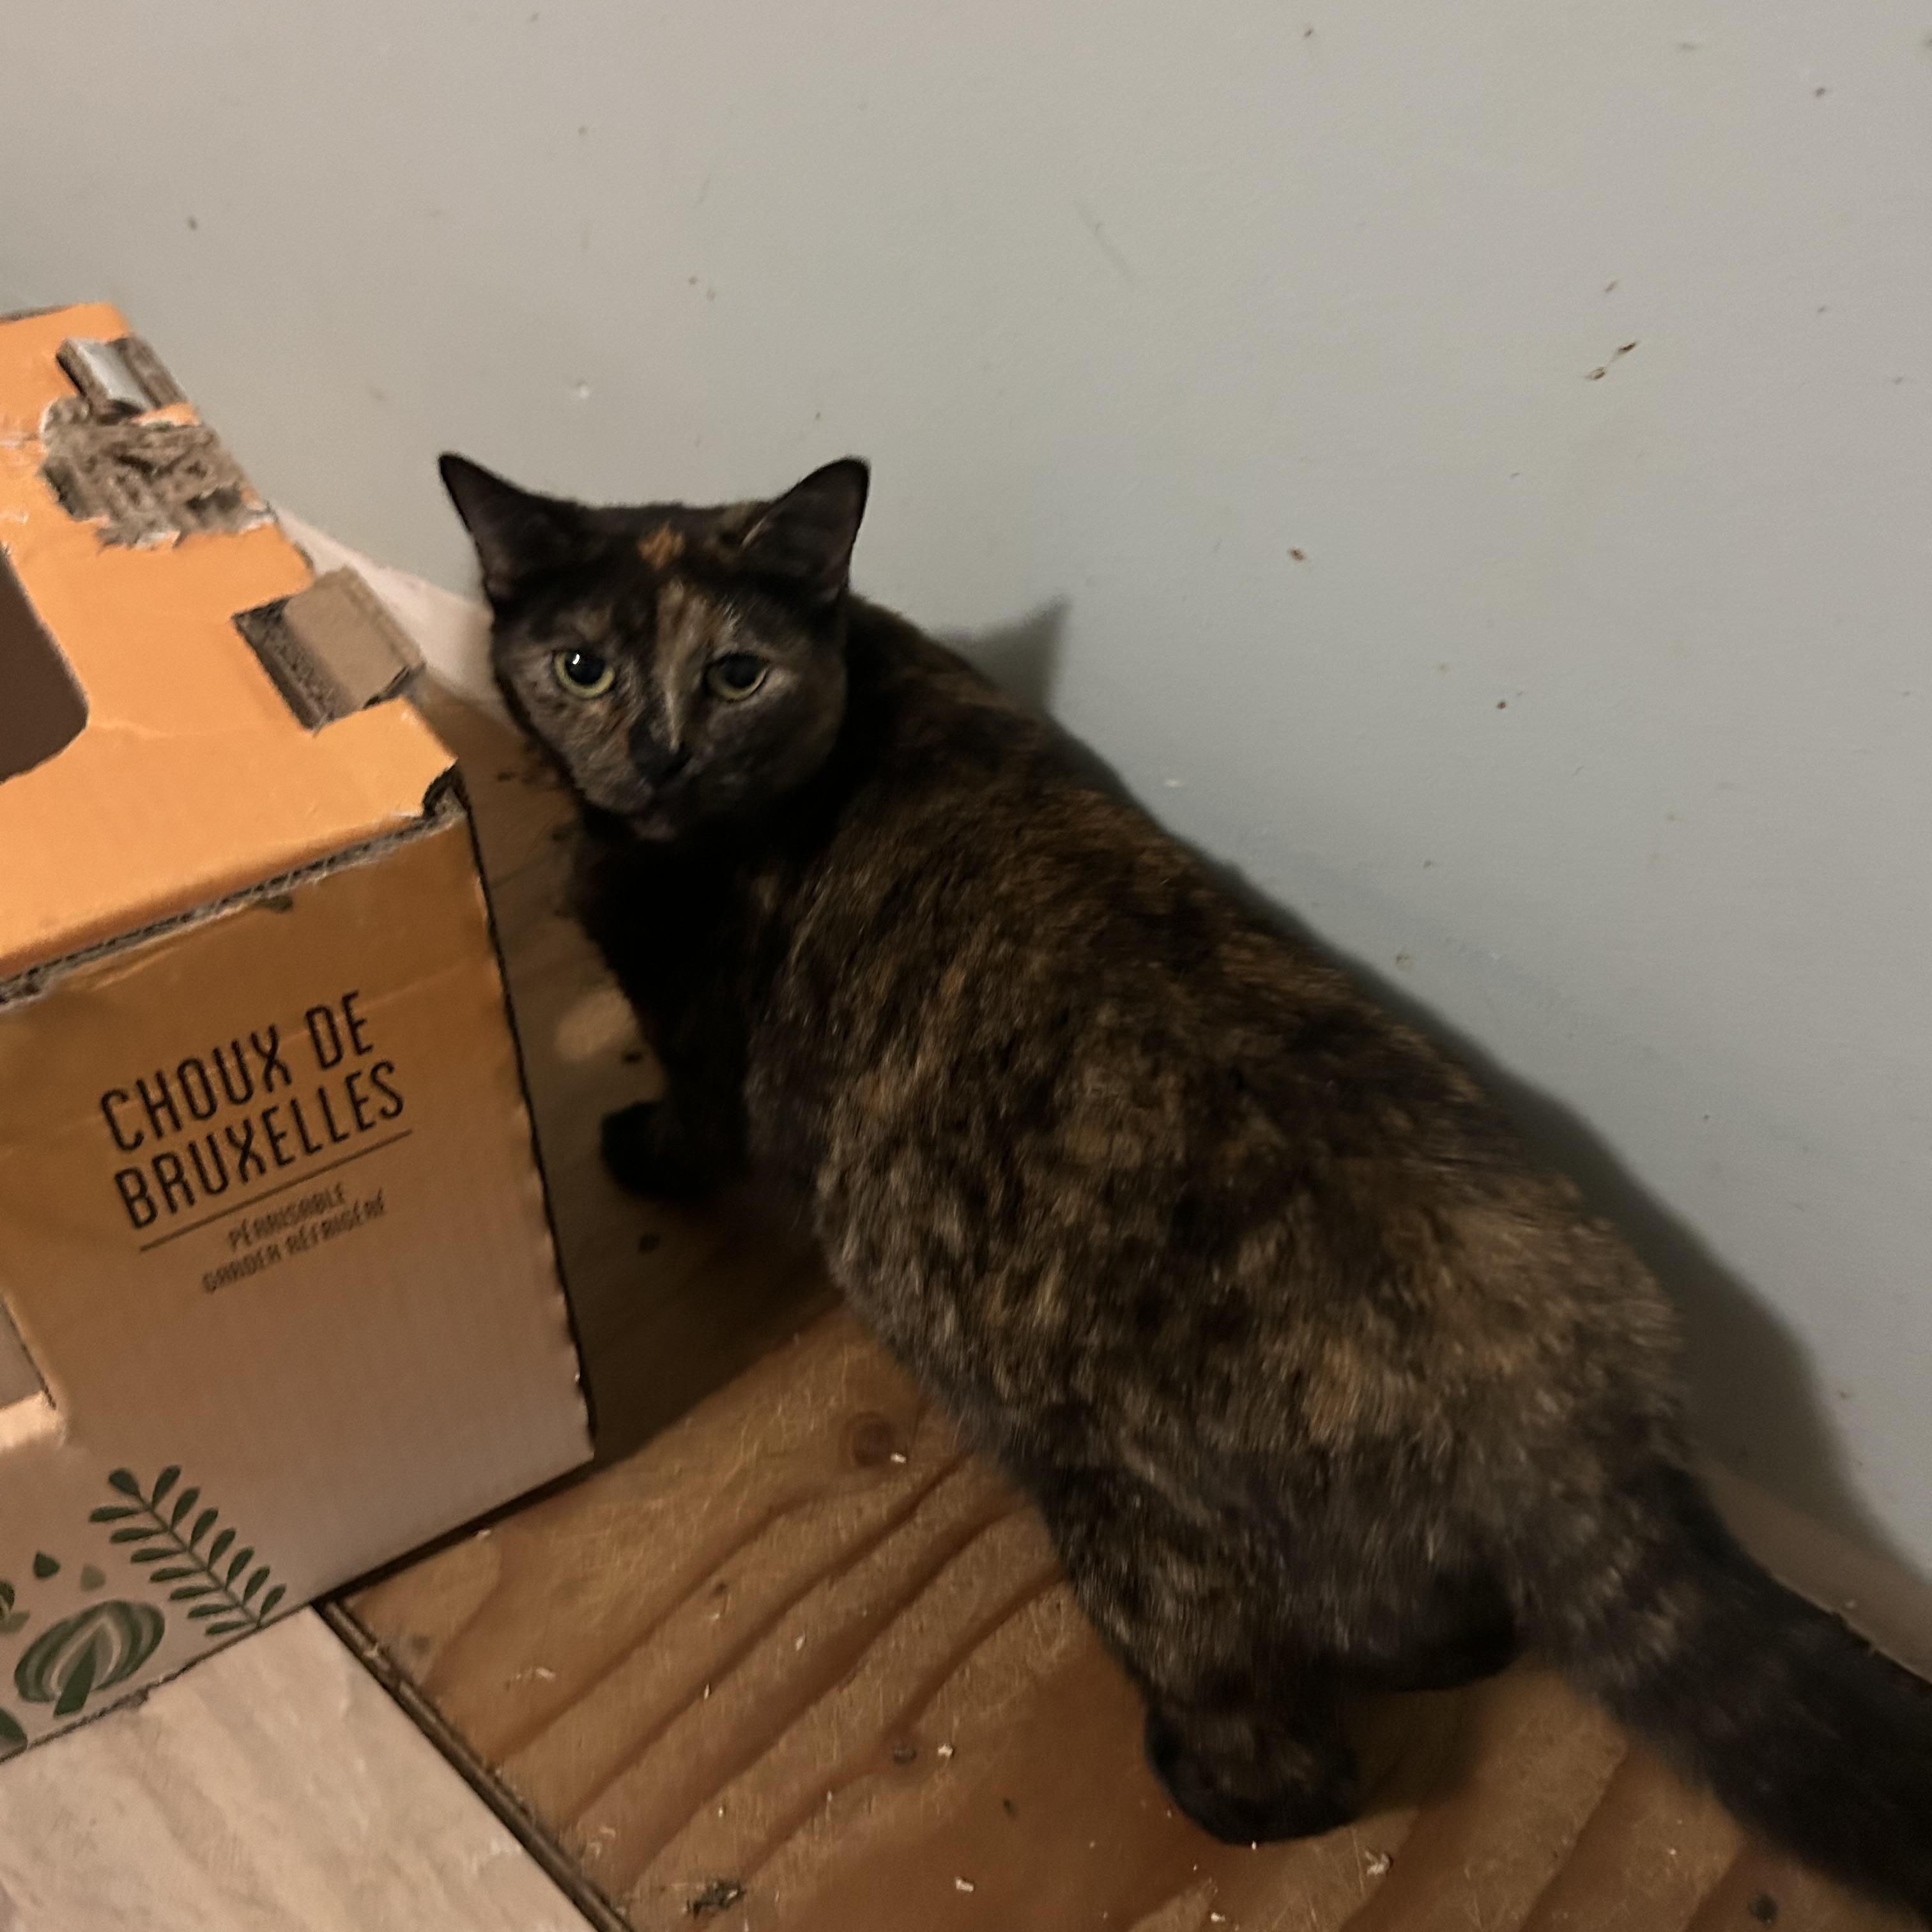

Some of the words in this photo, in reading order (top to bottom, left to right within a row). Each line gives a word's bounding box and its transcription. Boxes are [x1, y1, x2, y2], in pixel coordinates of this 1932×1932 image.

[100, 1025, 292, 1153] CHOUX
[305, 990, 373, 1069] DE
[114, 1061, 404, 1229] BRUXELLES
